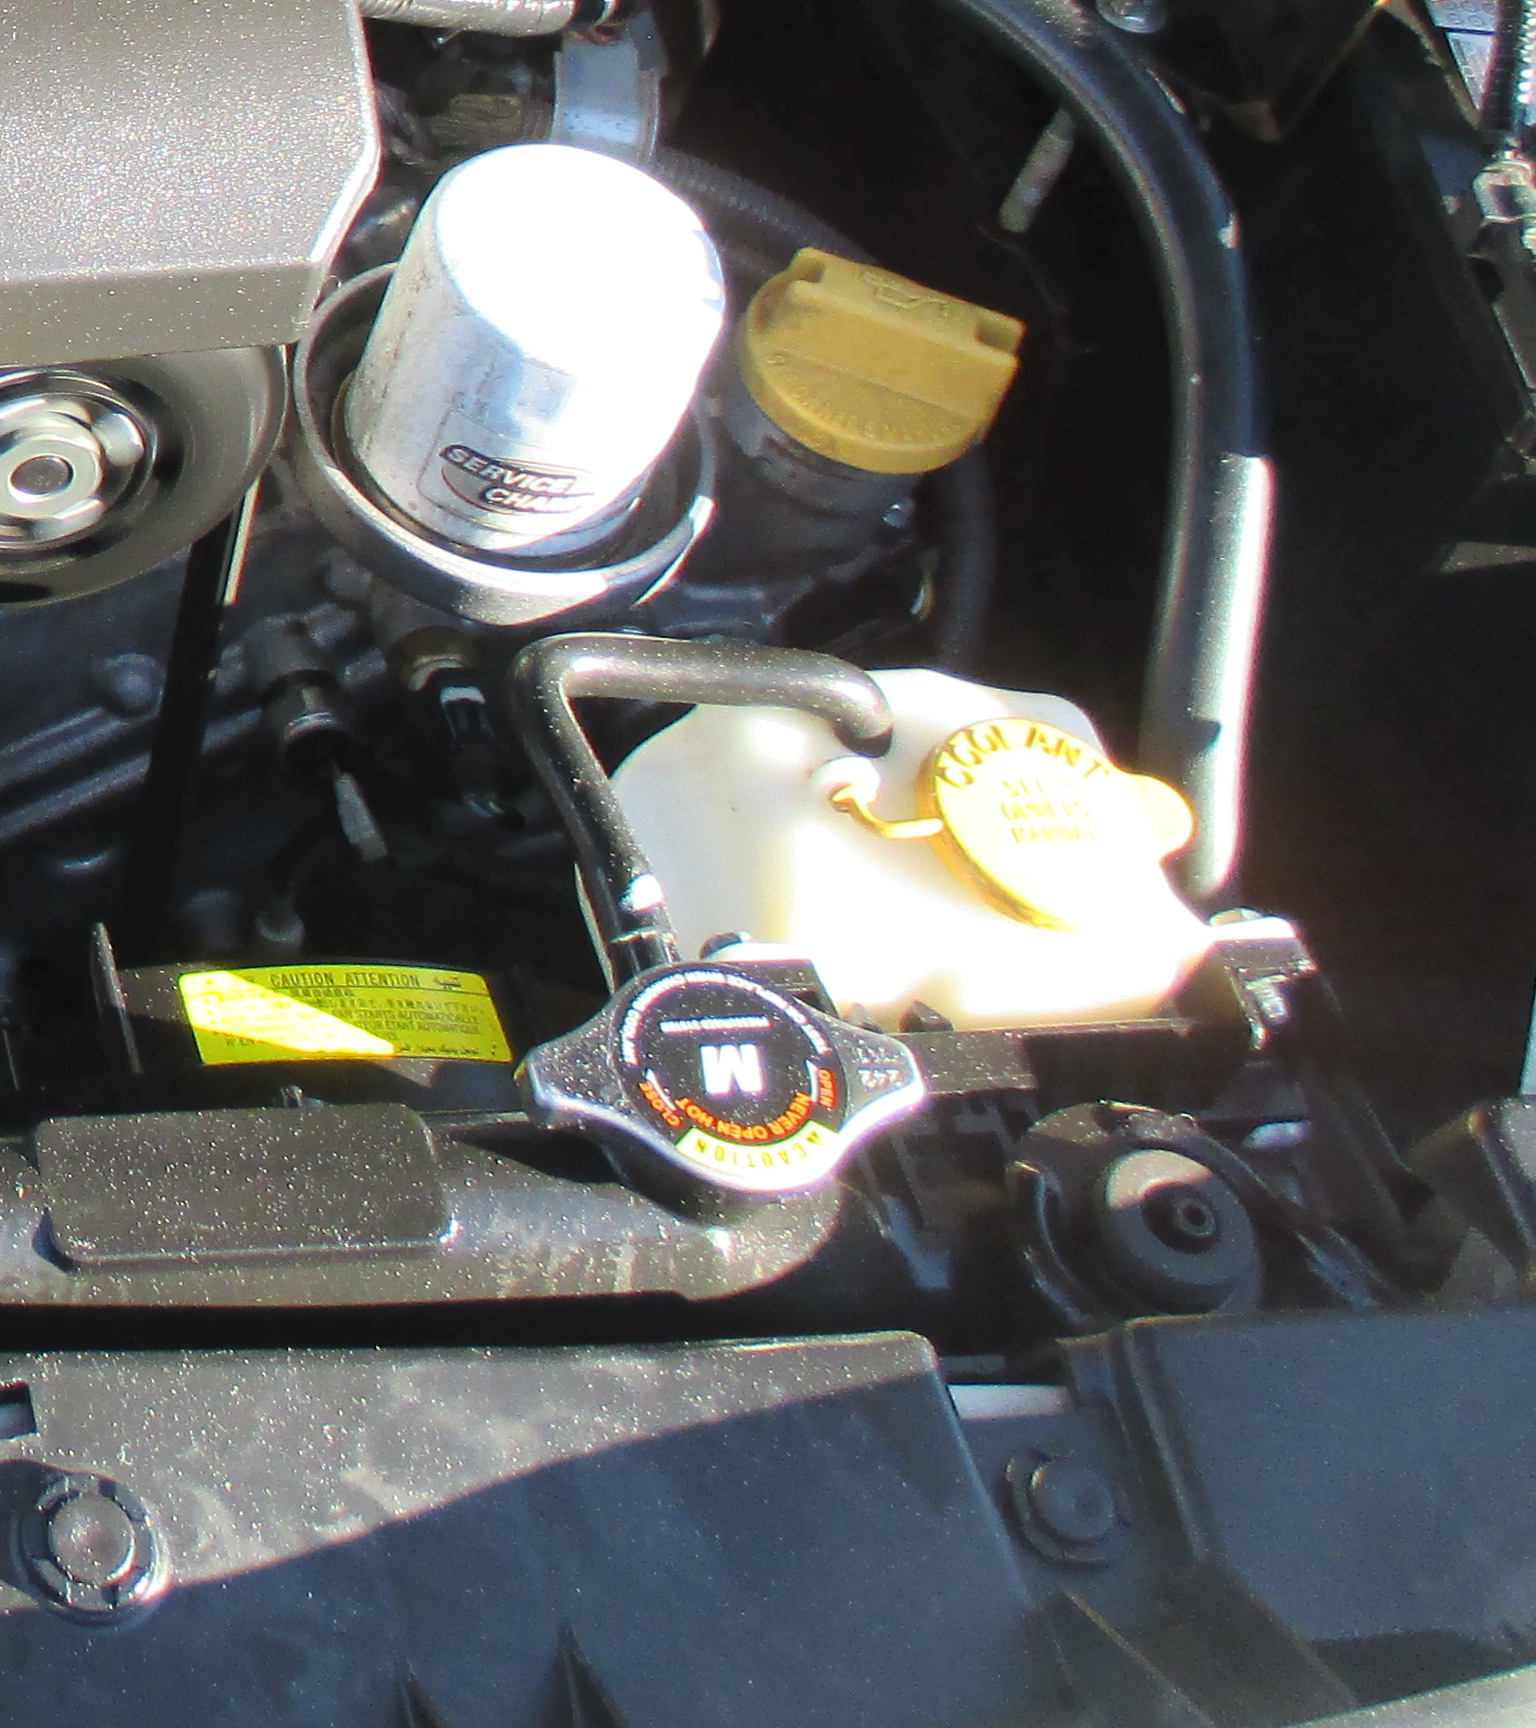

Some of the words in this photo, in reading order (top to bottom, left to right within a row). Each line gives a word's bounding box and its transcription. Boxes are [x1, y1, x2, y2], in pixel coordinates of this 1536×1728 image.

[444, 445, 576, 494] SERVICE
[485, 487, 580, 512] CHAM
[269, 972, 335, 988] CAUTION
[344, 972, 422, 989] ATTENTION
[638, 1081, 683, 1129] CLOSE
[817, 1068, 837, 1109] OPEN
[673, 1095, 718, 1130] HOT
[766, 1091, 812, 1138] NEVER
[716, 1120, 769, 1142] OPEN
[692, 1137, 809, 1170] CAUTION
